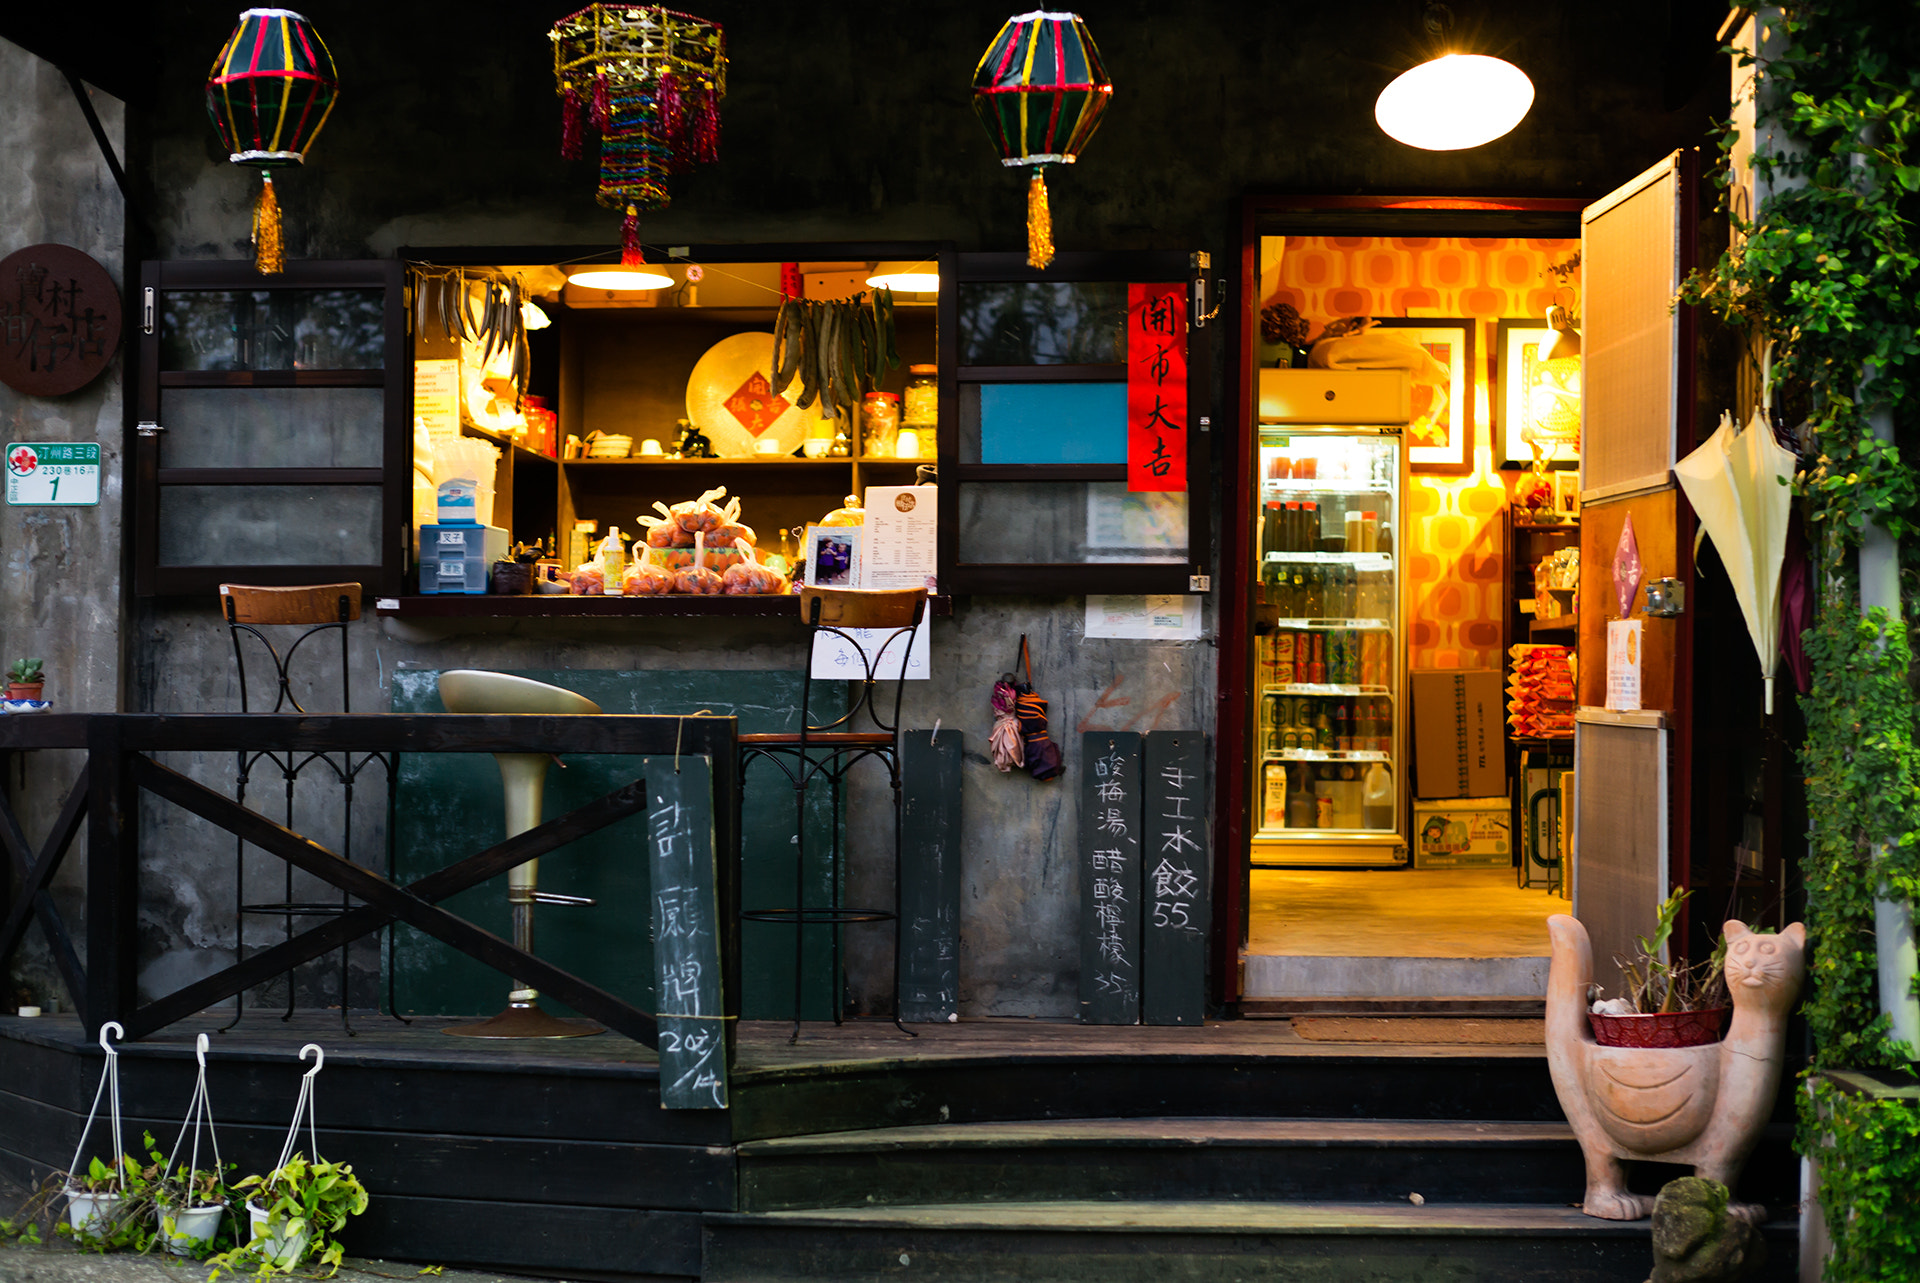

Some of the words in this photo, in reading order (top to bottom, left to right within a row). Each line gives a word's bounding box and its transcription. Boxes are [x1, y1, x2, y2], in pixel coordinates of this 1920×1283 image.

[1140, 297, 1180, 477] 開市大吉
[38, 446, 98, 460] 汀州路三段
[49, 476, 60, 501] 1
[442, 533, 461, 543] 叉子
[1151, 756, 1202, 899] 手工水餃
